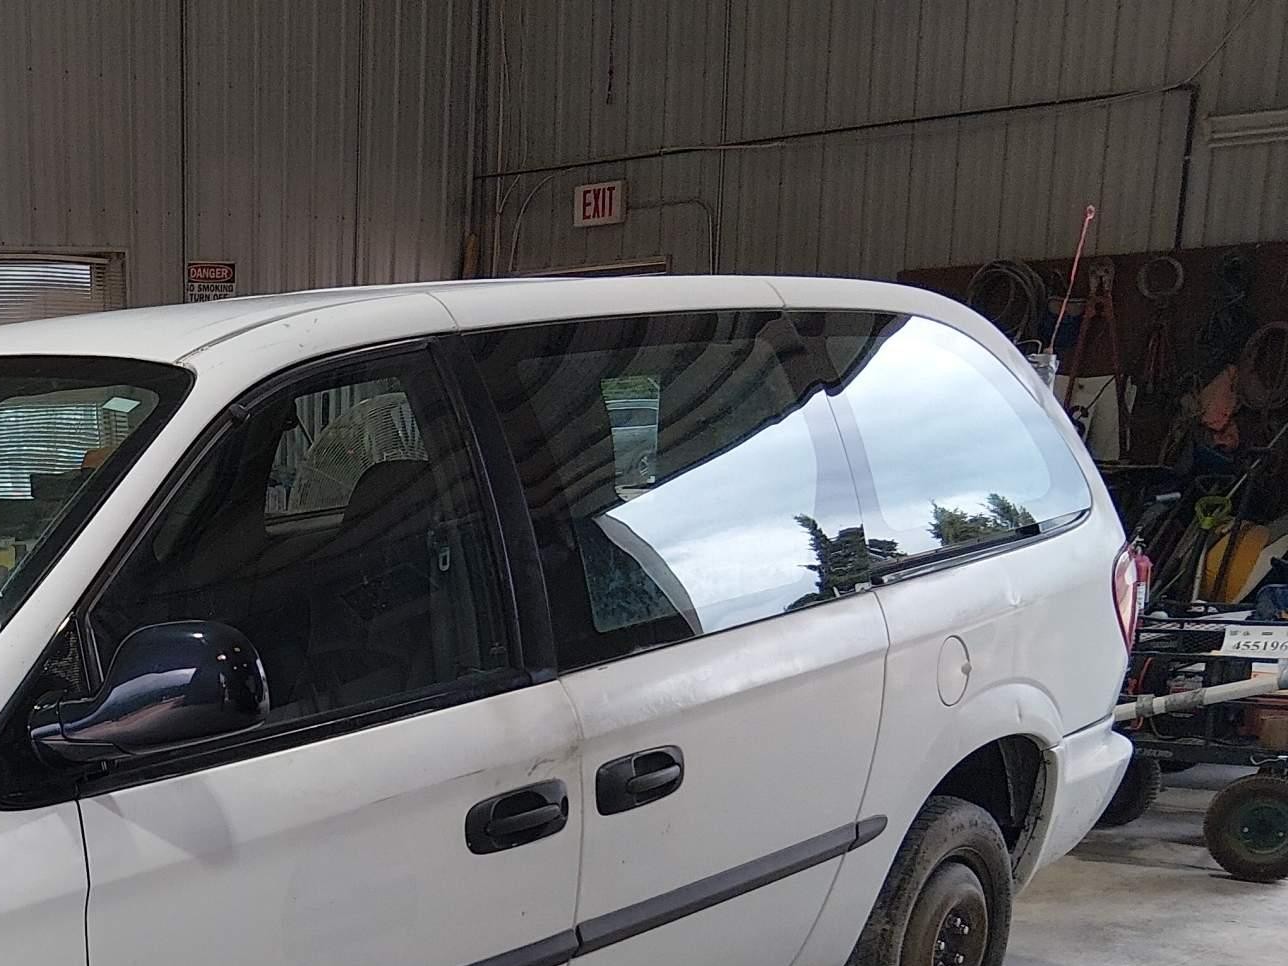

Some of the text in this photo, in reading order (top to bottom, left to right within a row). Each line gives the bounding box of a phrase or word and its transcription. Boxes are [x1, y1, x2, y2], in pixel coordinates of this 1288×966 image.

[583, 186, 616, 221] EXIT
[190, 267, 228, 279] DANGER
[197, 284, 234, 293] SMOKING
[189, 293, 211, 302] TURN
